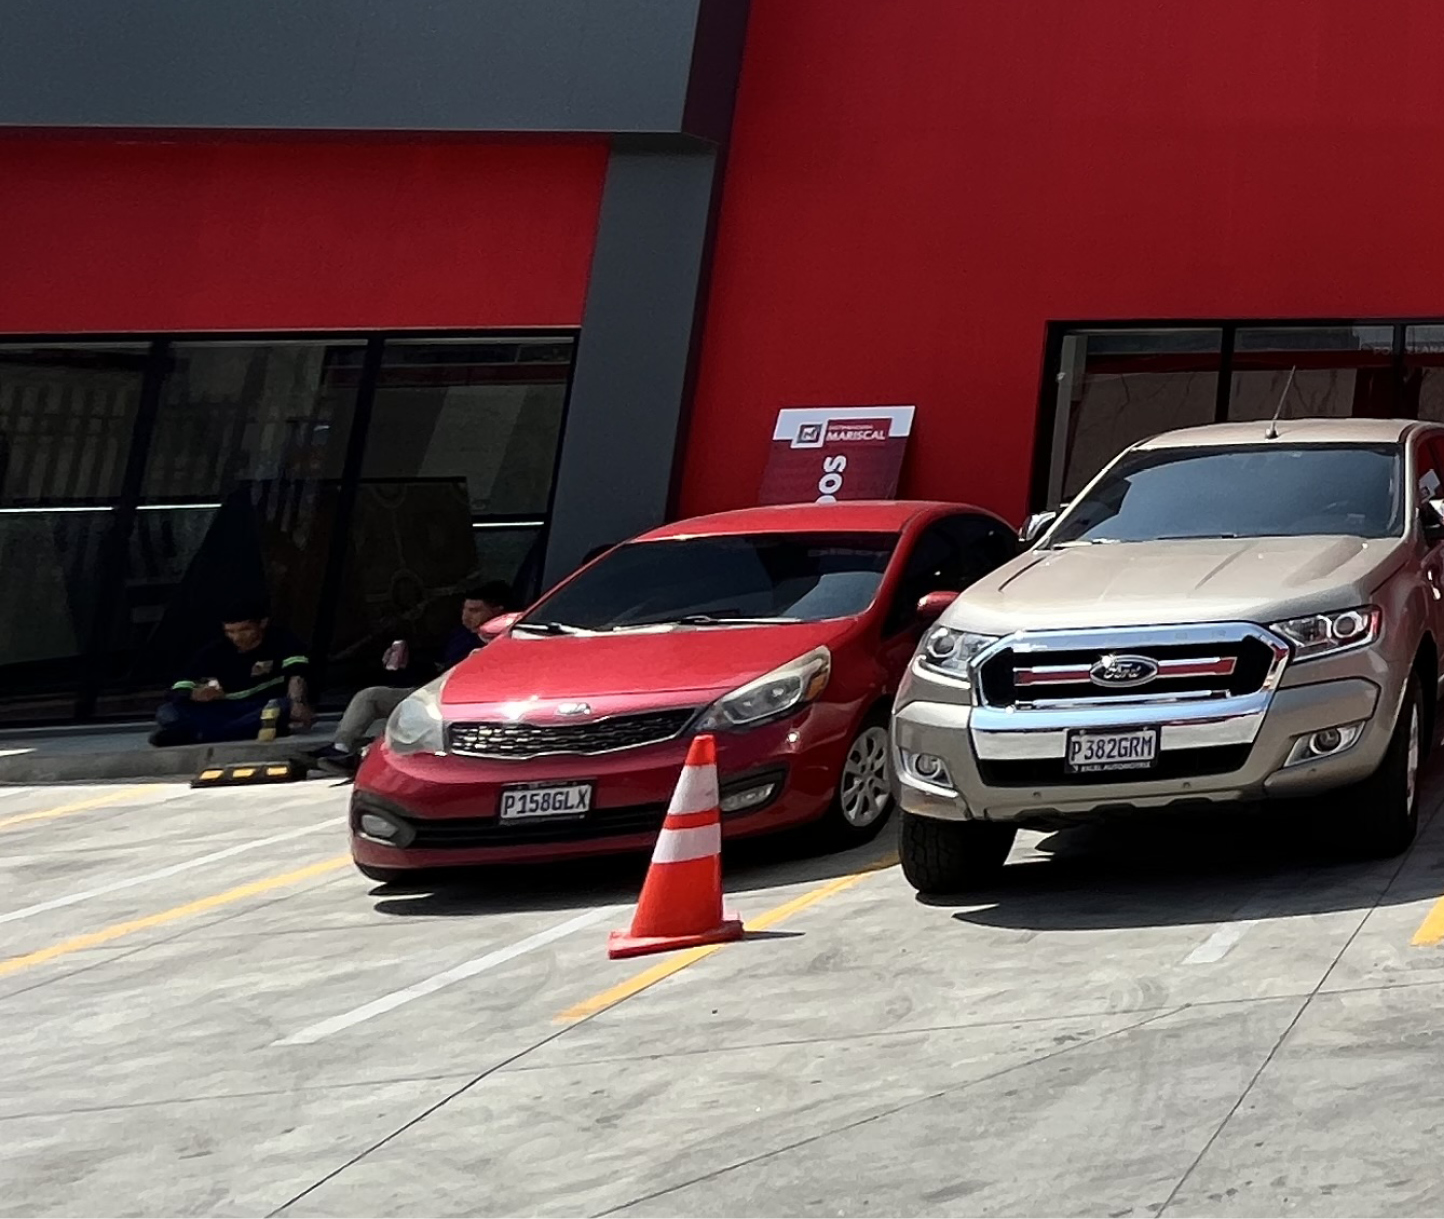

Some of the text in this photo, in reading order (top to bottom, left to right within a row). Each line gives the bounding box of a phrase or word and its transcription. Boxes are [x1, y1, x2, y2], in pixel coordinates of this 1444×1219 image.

[826, 430, 886, 442] MARISCAL
[1070, 735, 1154, 762] P382GRM
[503, 787, 589, 816] P158GLX
